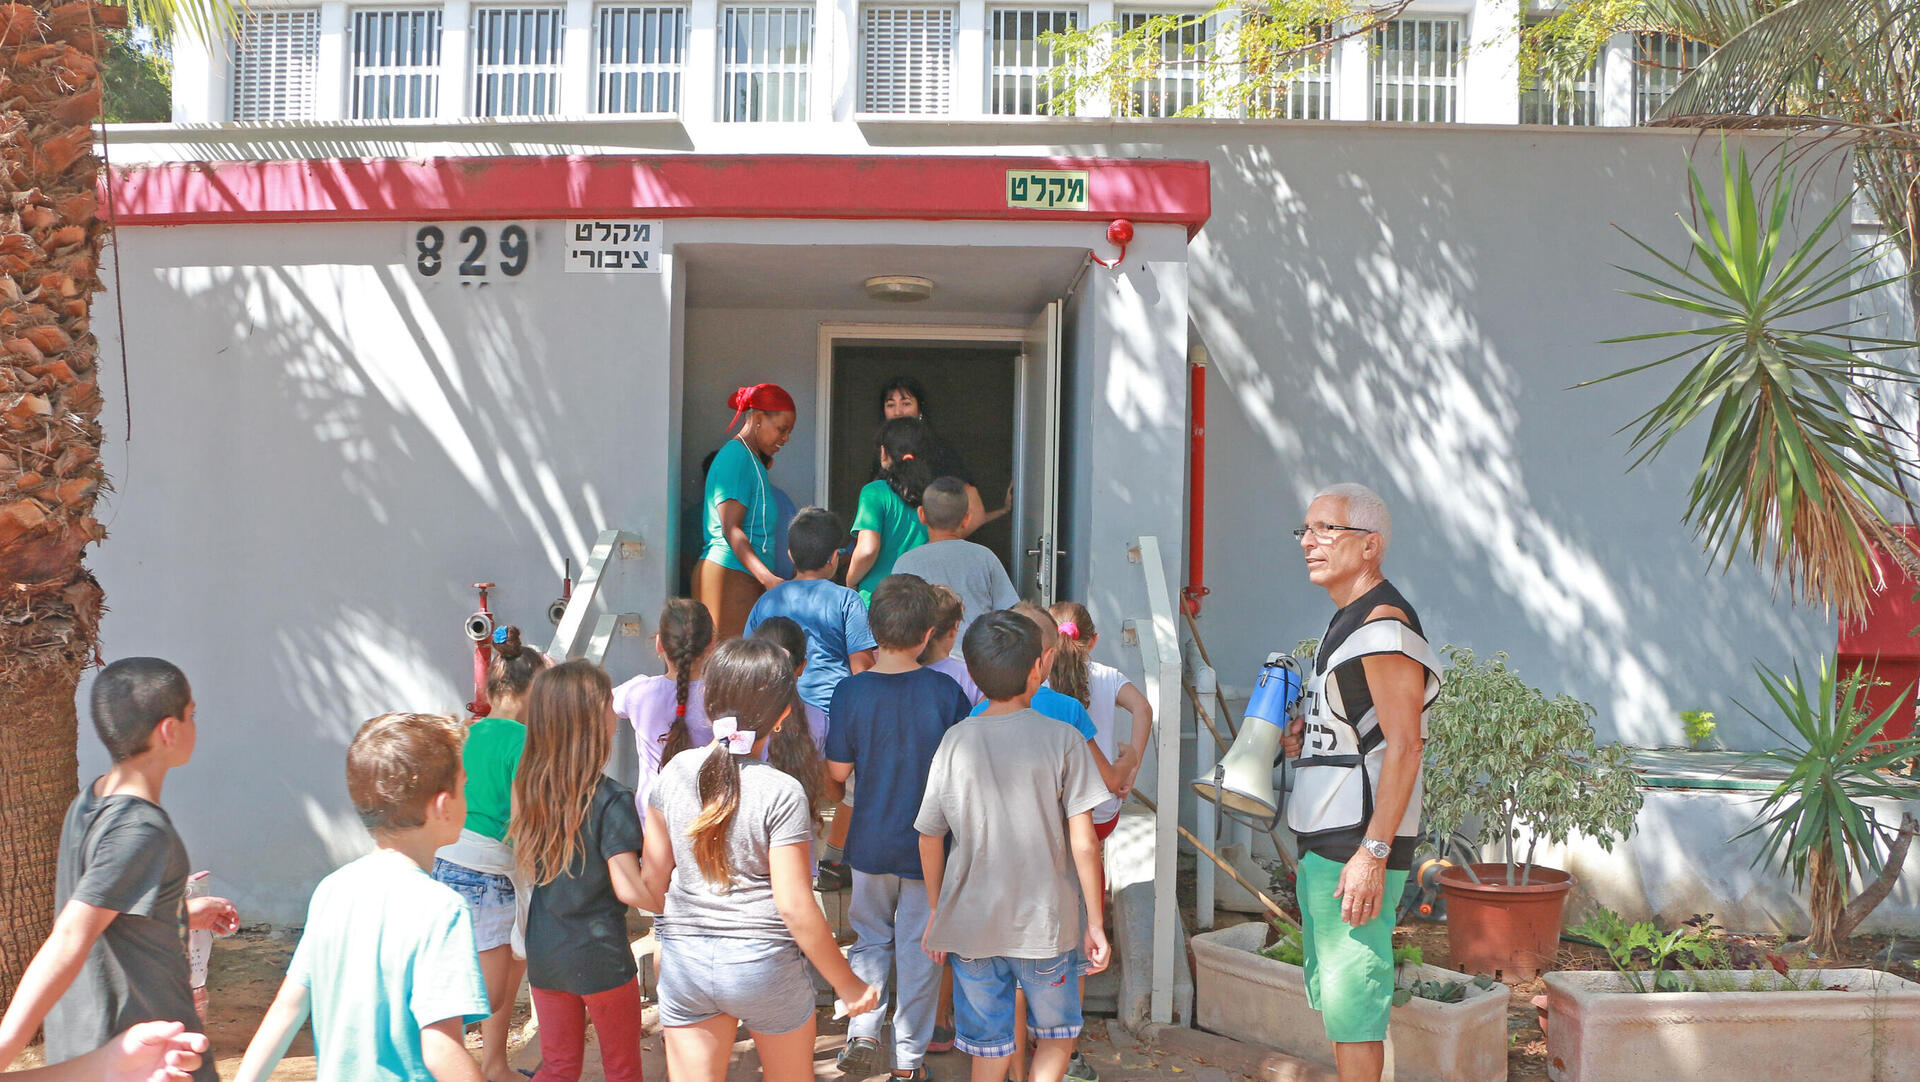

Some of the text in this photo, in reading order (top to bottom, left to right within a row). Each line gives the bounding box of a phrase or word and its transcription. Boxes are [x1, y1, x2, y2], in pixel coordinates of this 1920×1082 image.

[1011, 175, 1084, 207] מקלט
[575, 222, 650, 245] מקלט
[416, 224, 529, 277] 829
[572, 250, 649, 269] ציבורי
